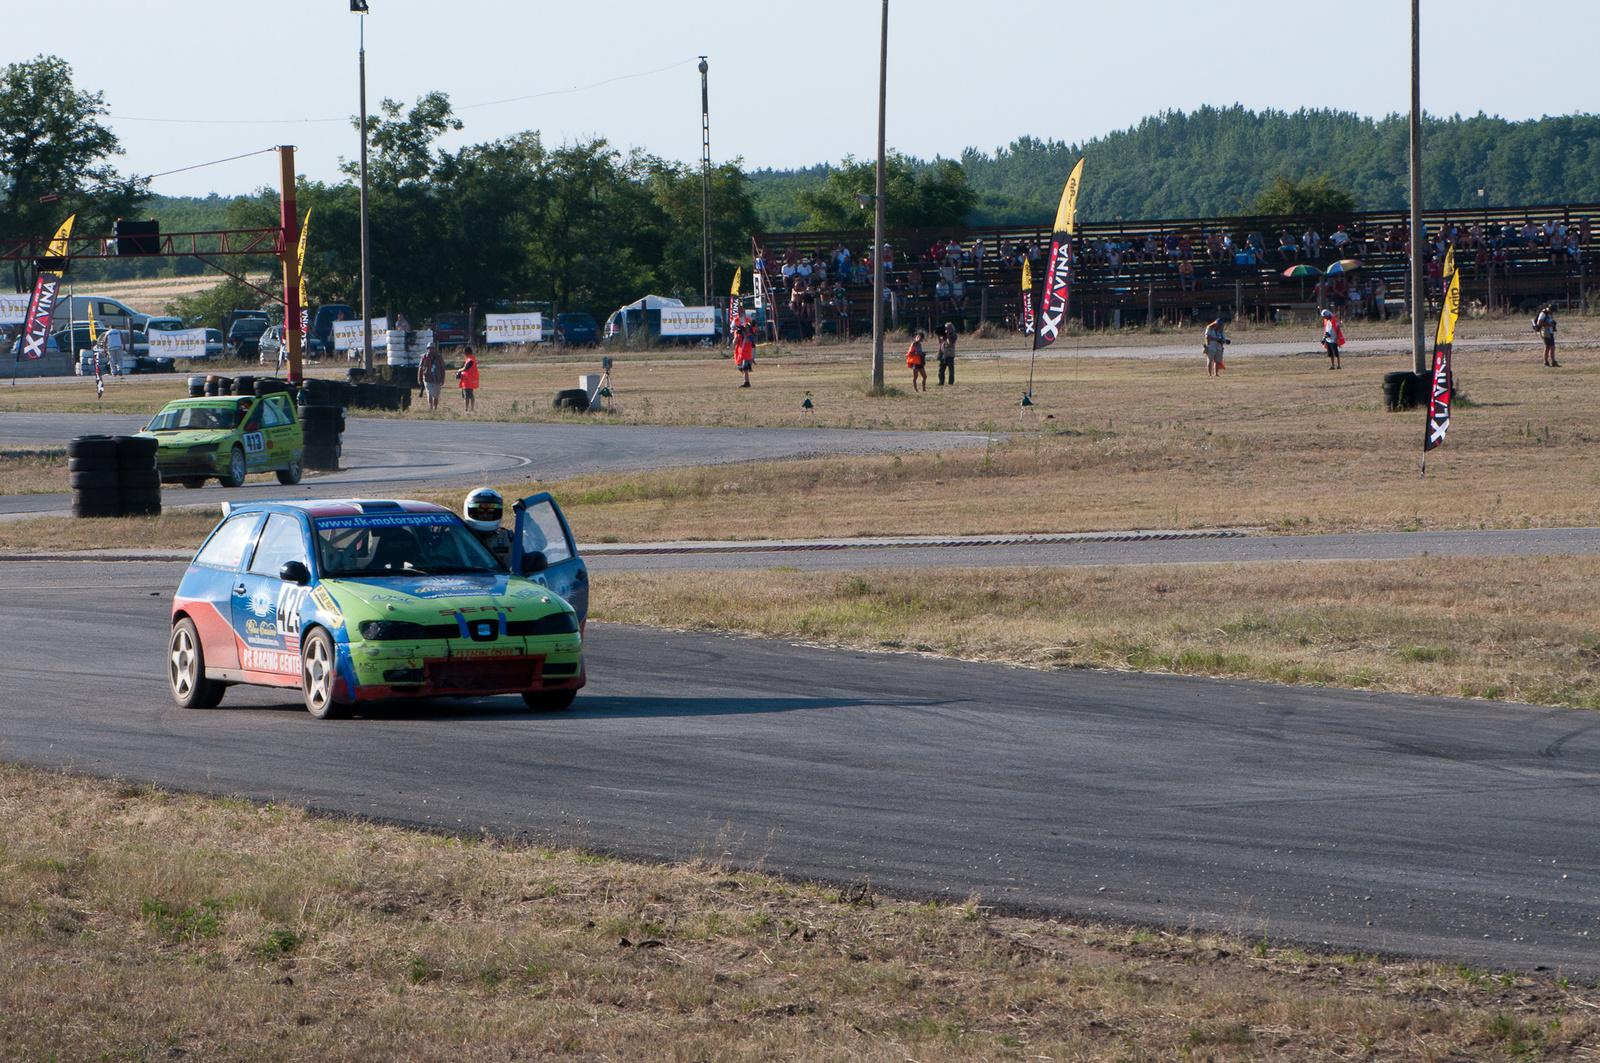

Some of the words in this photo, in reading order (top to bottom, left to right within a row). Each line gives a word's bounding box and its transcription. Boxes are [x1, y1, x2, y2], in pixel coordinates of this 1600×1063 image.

[246, 433, 262, 451] 413
[318, 515, 453, 529] www.fk-motorsport.at
[277, 587, 308, 634] 429
[438, 606, 516, 617] SEAT
[243, 648, 253, 668] PS
[253, 650, 279, 672] RACING
